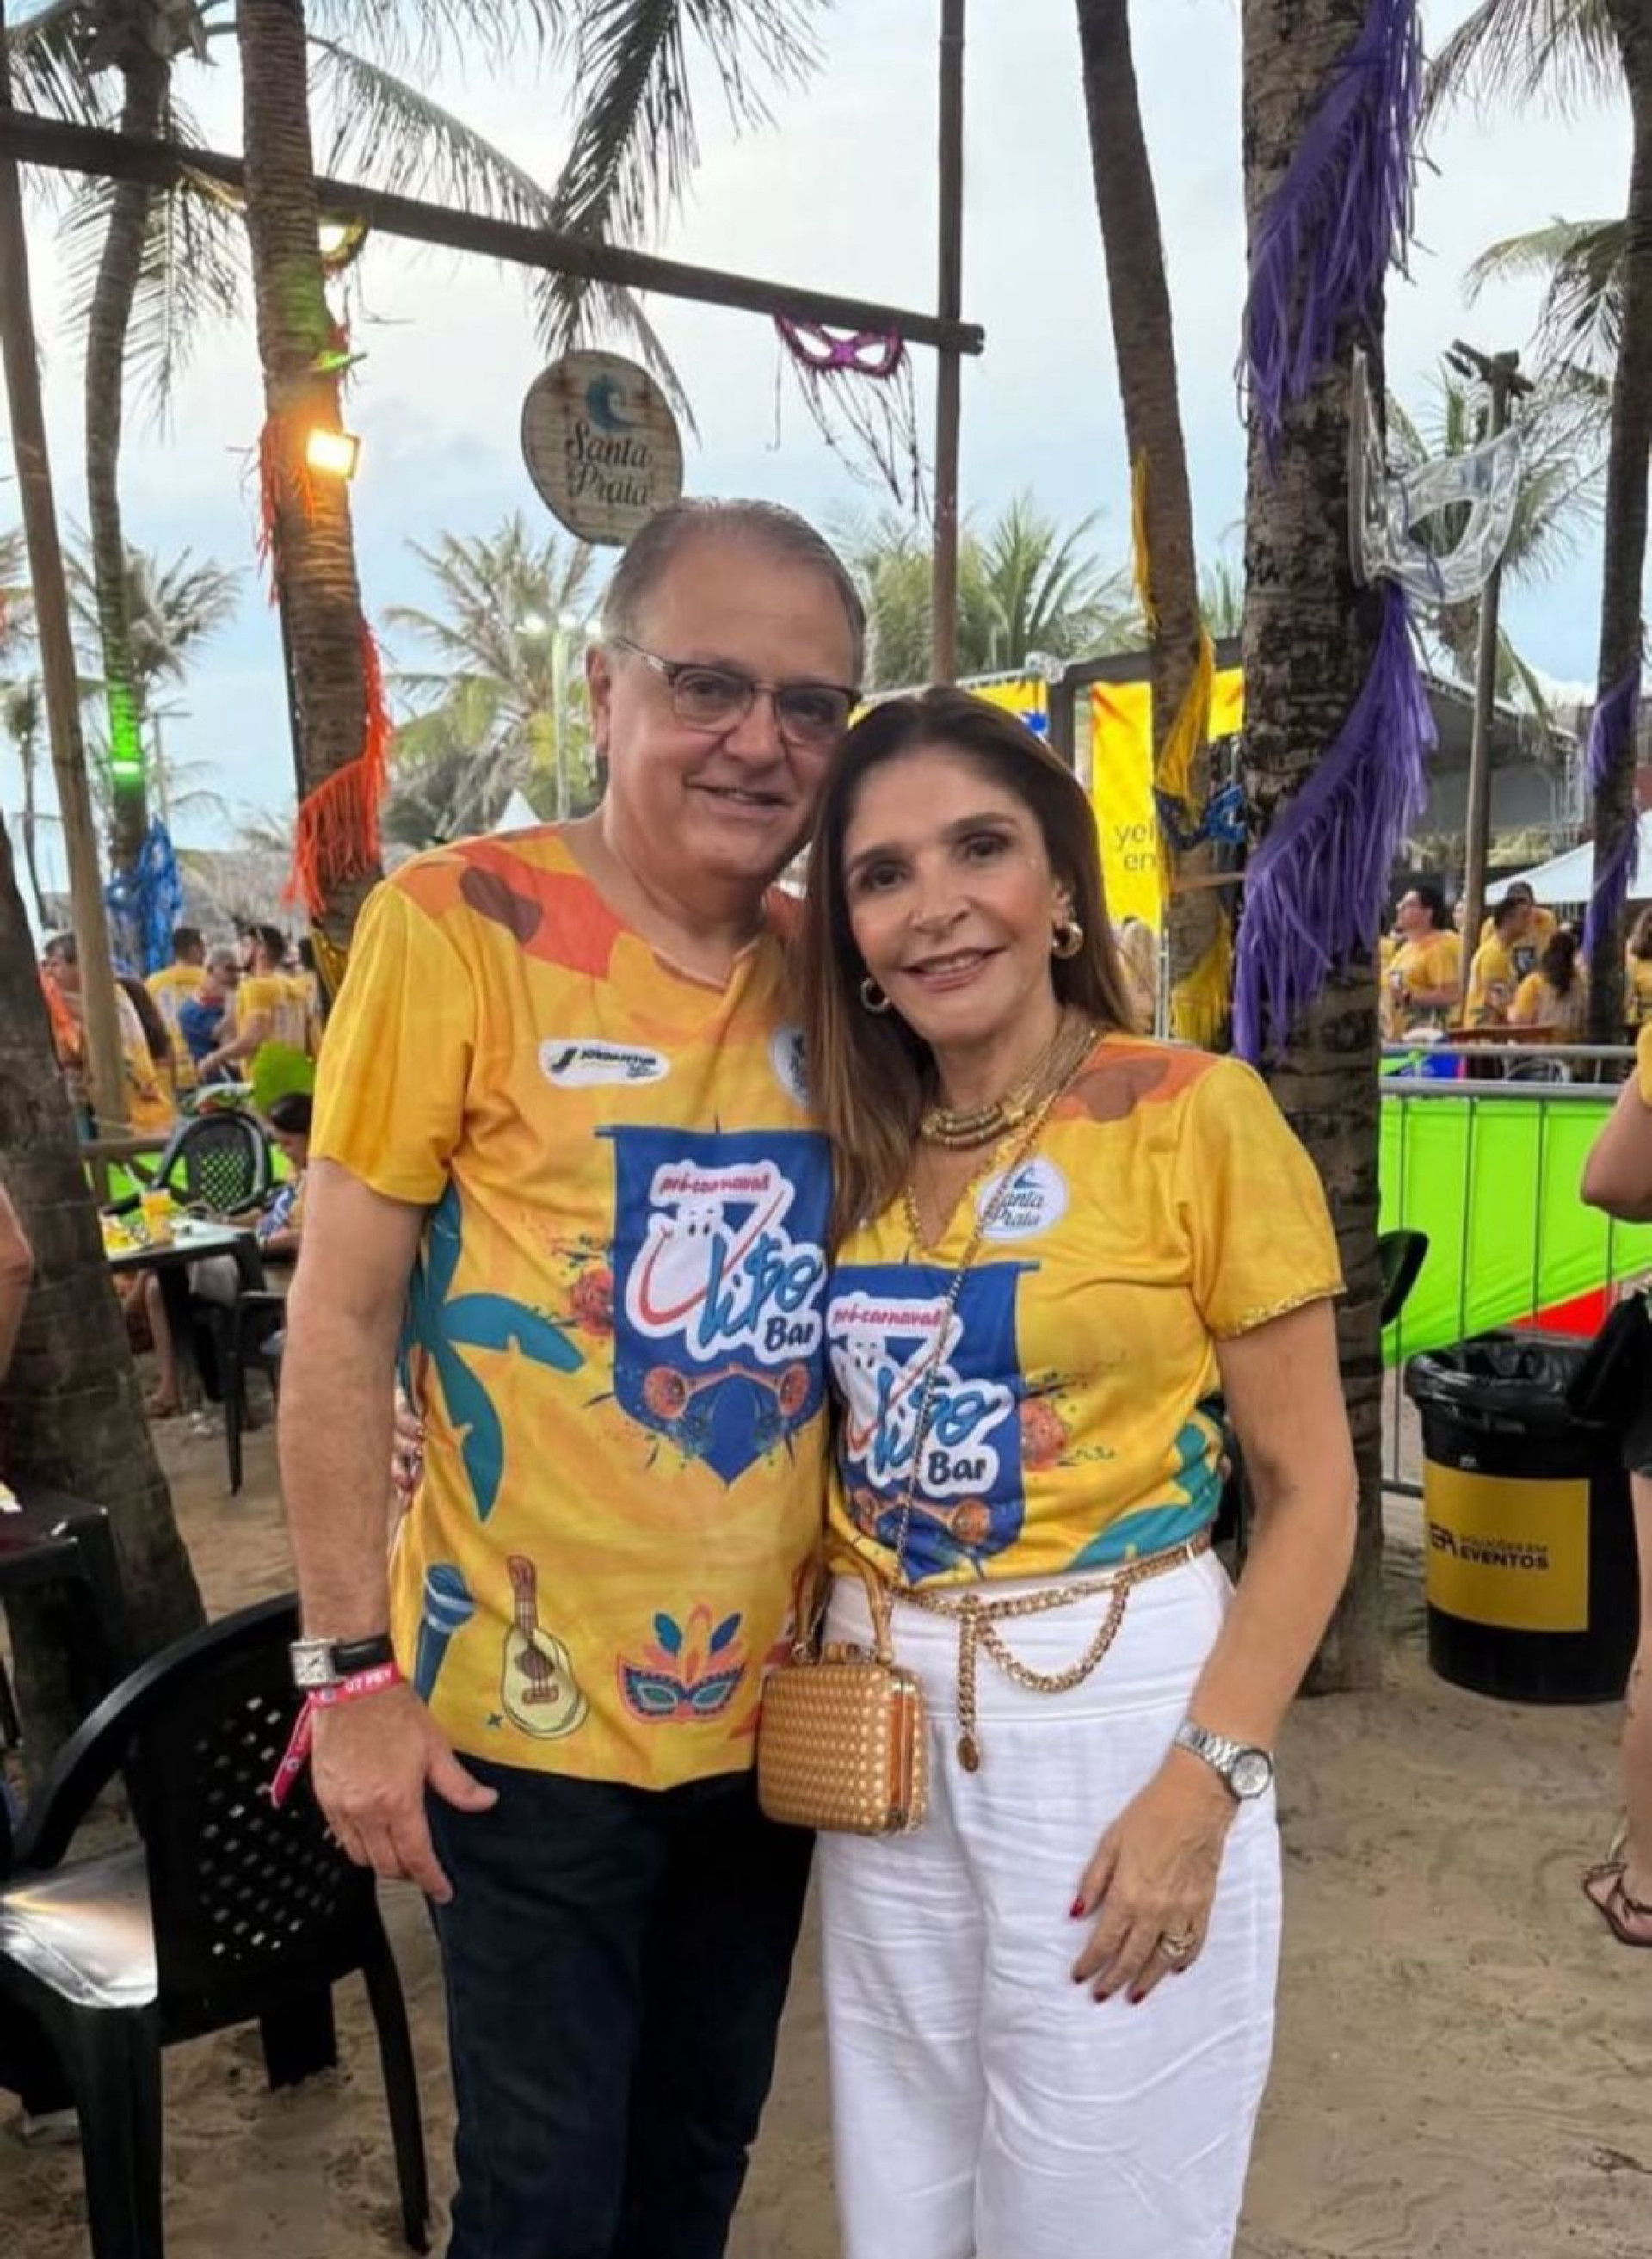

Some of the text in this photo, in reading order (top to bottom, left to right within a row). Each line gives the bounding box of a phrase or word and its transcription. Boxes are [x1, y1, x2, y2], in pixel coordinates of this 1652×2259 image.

[565, 420, 653, 468] Santa
[567, 463, 655, 506] Praia
[659, 1171, 771, 1195] pré-carnaval
[833, 1303, 941, 1327] pré-carnaval
[764, 1315, 814, 1352] Bar
[927, 1449, 987, 1485] Bar
[1459, 1546, 1549, 1570] EVENTOS
